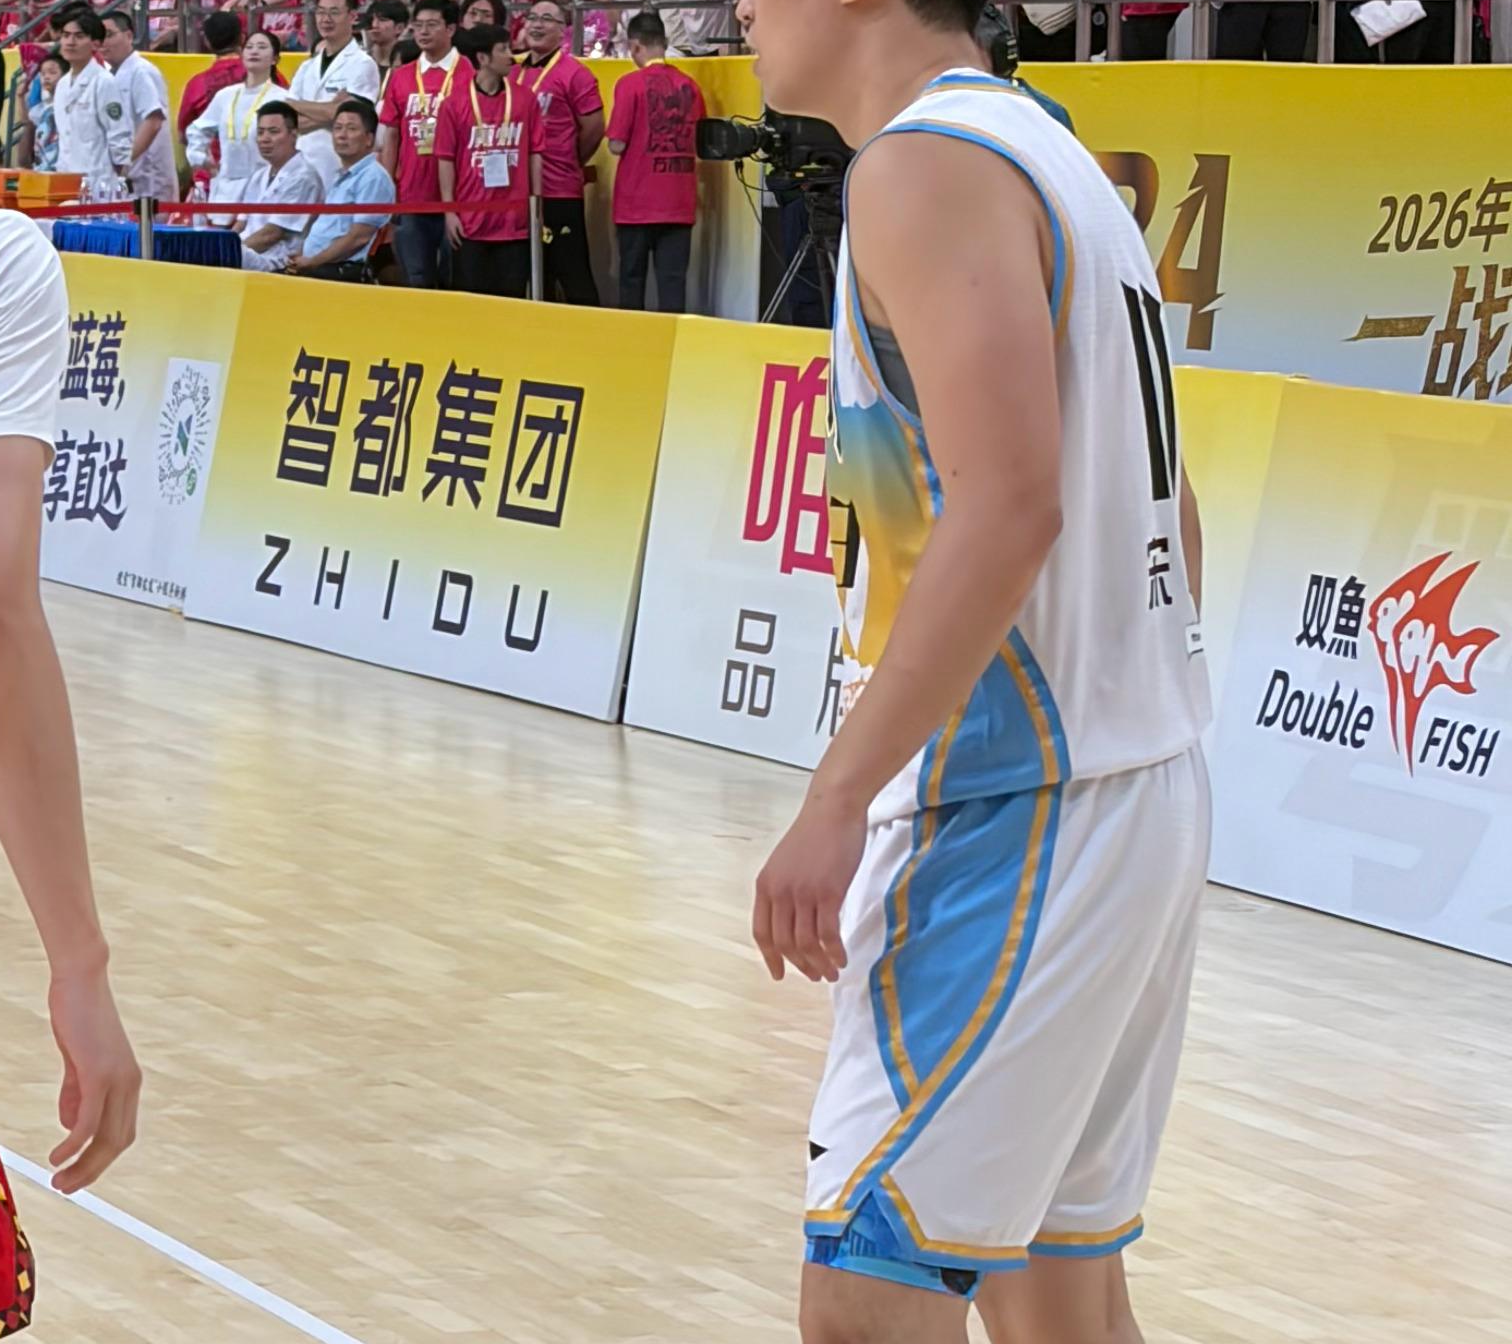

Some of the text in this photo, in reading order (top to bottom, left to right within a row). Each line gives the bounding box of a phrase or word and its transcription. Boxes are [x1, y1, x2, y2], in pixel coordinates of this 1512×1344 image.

[1367, 177, 1512, 254] 2026年
[43, 429, 128, 531] 享直达
[275, 346, 585, 528] 智都集团
[255, 533, 550, 653] ZHIDU
[1256, 668, 1375, 750] Double
[1418, 716, 1501, 777] FISH
